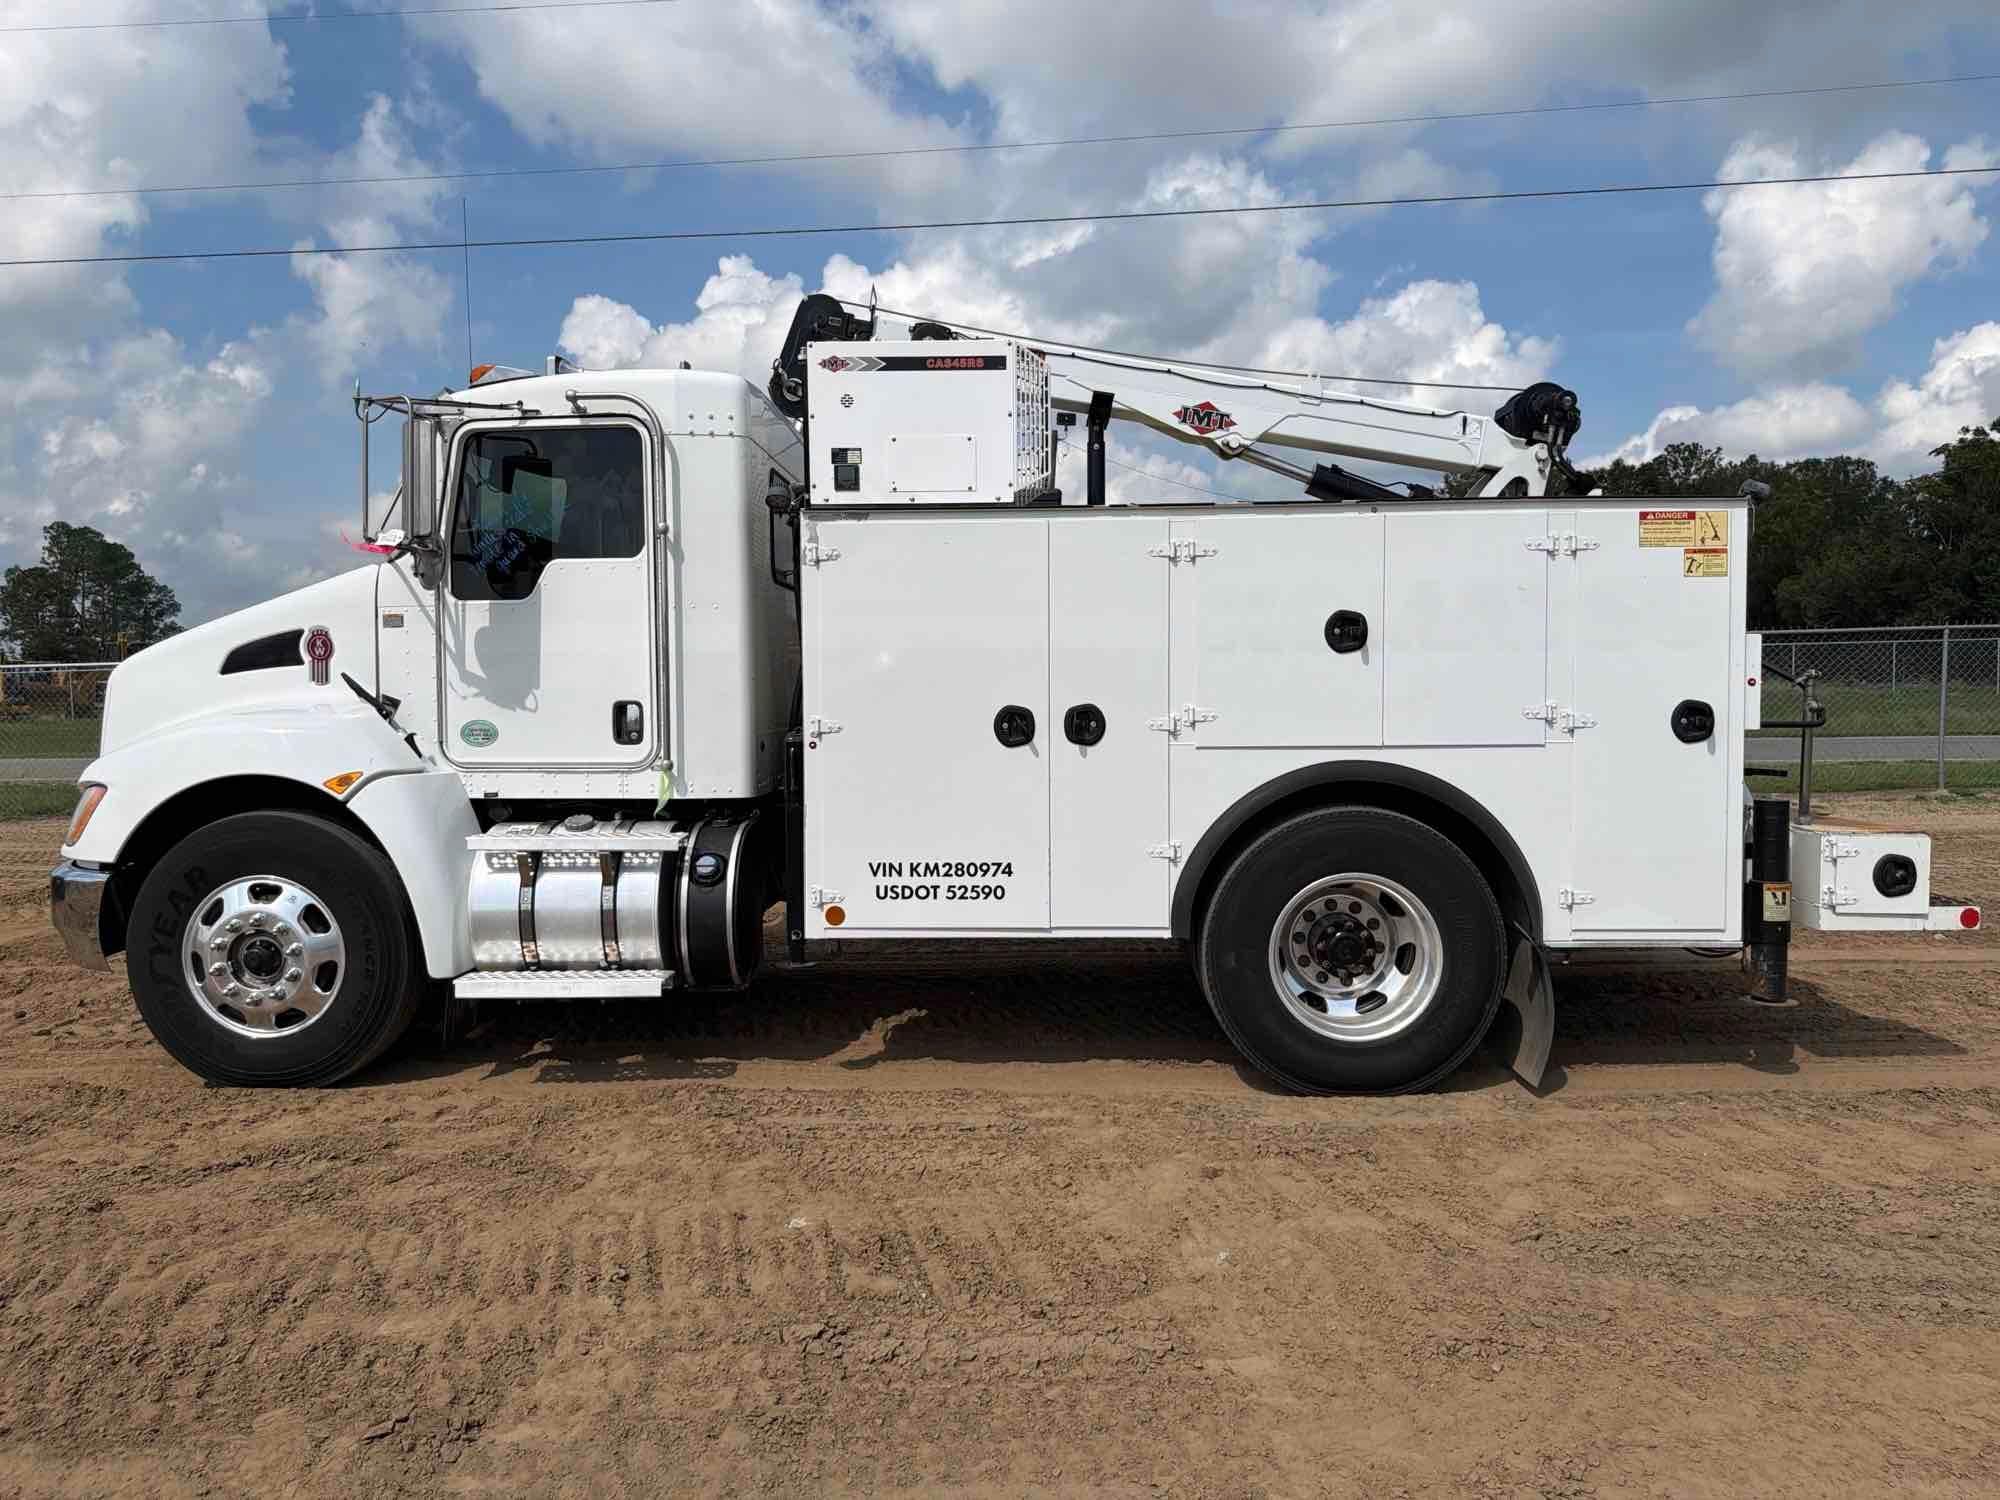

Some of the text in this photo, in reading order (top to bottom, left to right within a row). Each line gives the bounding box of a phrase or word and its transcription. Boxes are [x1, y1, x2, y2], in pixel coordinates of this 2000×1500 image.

[820, 357, 849, 370] IMT
[1180, 404, 1232, 431] IMT
[1655, 512, 1689, 520] DANGER
[868, 862, 1014, 878] VIN KM280974
[875, 885, 1006, 900] USDOT 52590
